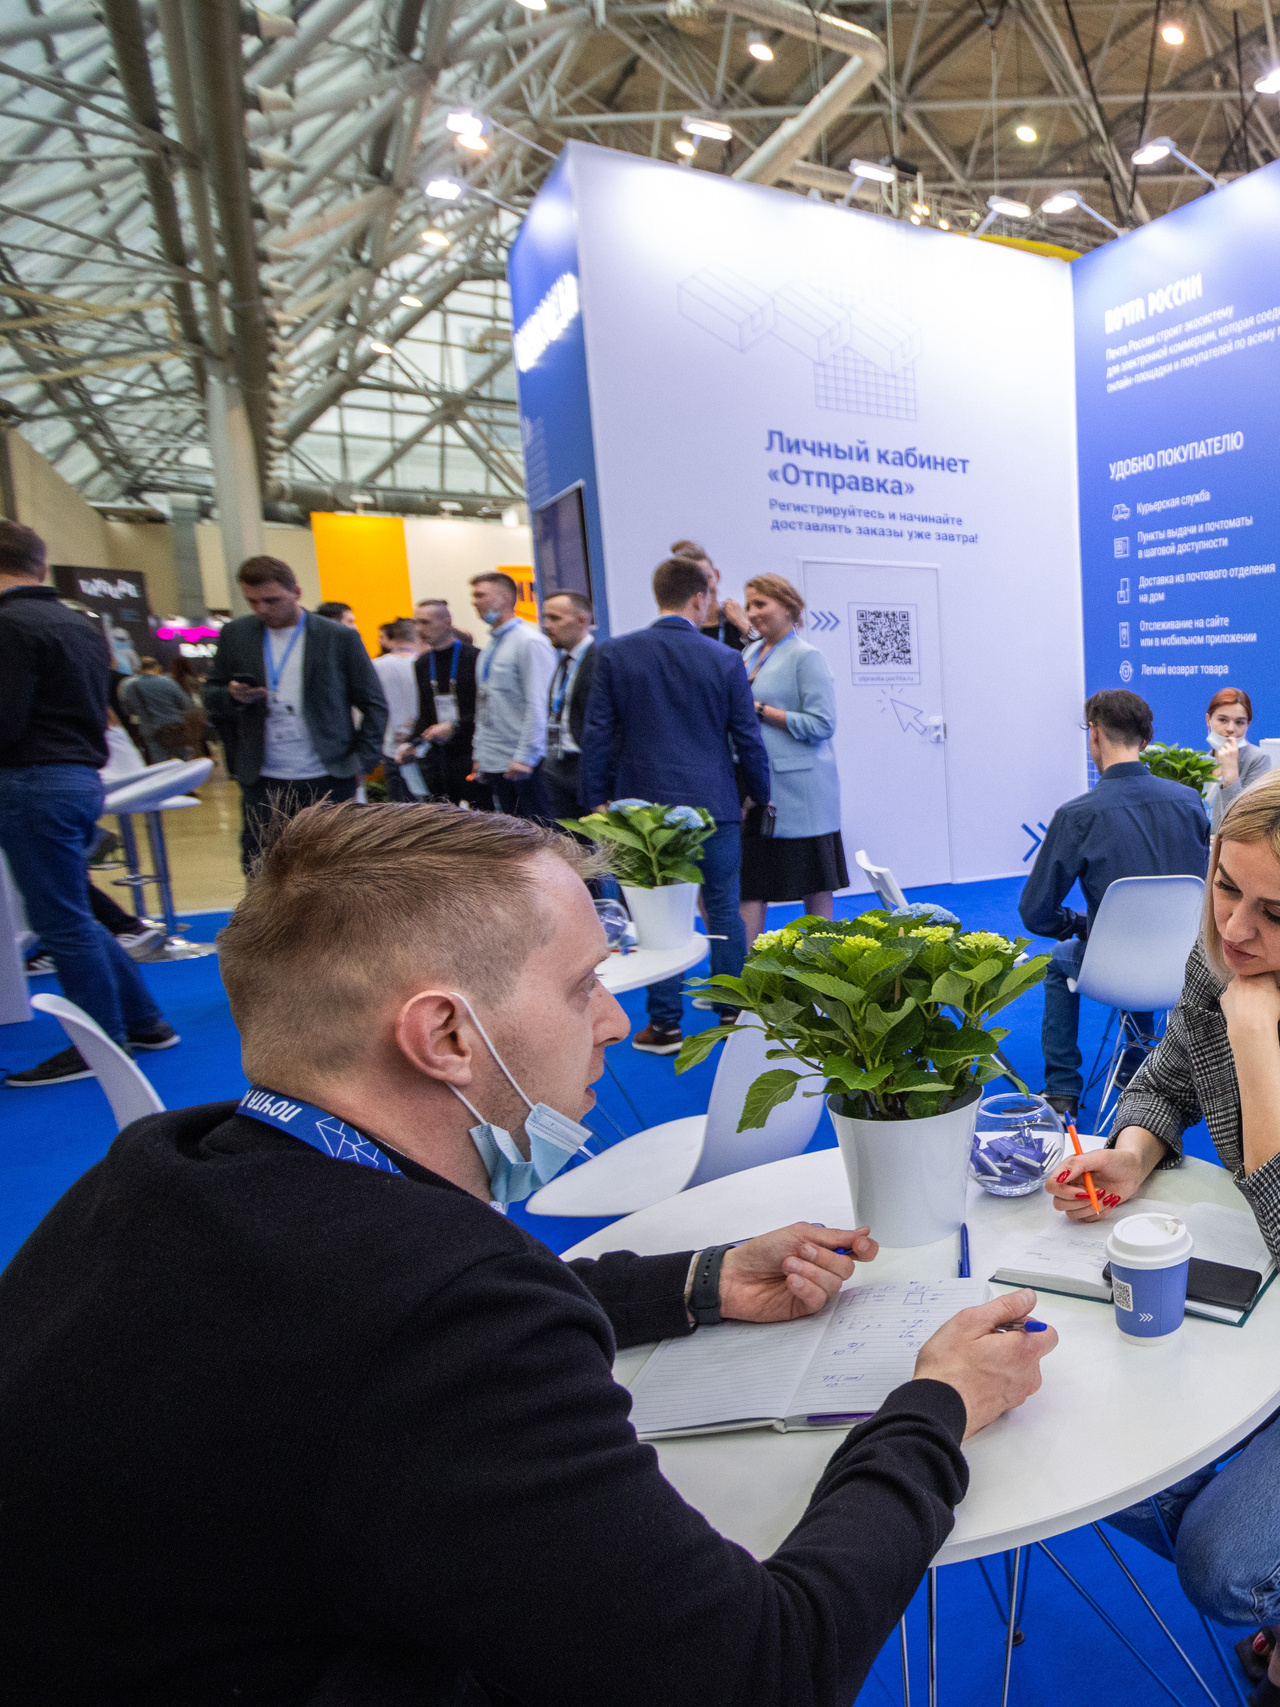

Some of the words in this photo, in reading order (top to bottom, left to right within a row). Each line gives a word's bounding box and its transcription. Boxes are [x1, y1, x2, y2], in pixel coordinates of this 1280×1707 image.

[765, 430, 870, 463] Личный
[877, 447, 970, 474] кабинет
[1109, 453, 1156, 481] УДОБНО
[1157, 431, 1244, 468] ПОКУПАТЕЛЮ
[768, 463, 914, 496] «Отправка»
[769, 498, 886, 519] Регистрируйтесь
[888, 512, 896, 520] и
[899, 513, 963, 526] начинайте
[1136, 497, 1180, 515] Курьерская
[1180, 489, 1211, 506] служба
[770, 519, 852, 534] доставлять
[856, 526, 904, 538] заказы
[907, 530, 931, 541] уже
[935, 532, 978, 545] завтра!
[1137, 530, 1166, 544] Пункты
[1166, 525, 1198, 539] выдачи
[1197, 524, 1204, 533] и
[1204, 516, 1253, 532] почтоматы
[1138, 549, 1143, 559] в
[1142, 542, 1176, 558] шаговой
[1176, 537, 1228, 555] доступности
[1138, 575, 1174, 589] Доставка
[1174, 573, 1185, 583] из
[1185, 568, 1228, 582] почтового
[1228, 563, 1276, 579] отделения
[1139, 593, 1149, 603] на
[1148, 592, 1165, 604] дом
[1139, 619, 1194, 632] Отслеживание
[1193, 618, 1205, 628] на
[1204, 615, 1230, 628] сайте
[1140, 638, 1154, 647] или
[1153, 637, 1160, 647] в
[1159, 634, 1205, 646] мобильном
[1205, 633, 1257, 646] приложении
[1141, 663, 1167, 675] Легкий
[1166, 665, 1199, 676] возврат
[1200, 665, 1229, 676] товара
[247, 1090, 303, 1123] ПОЧТА
